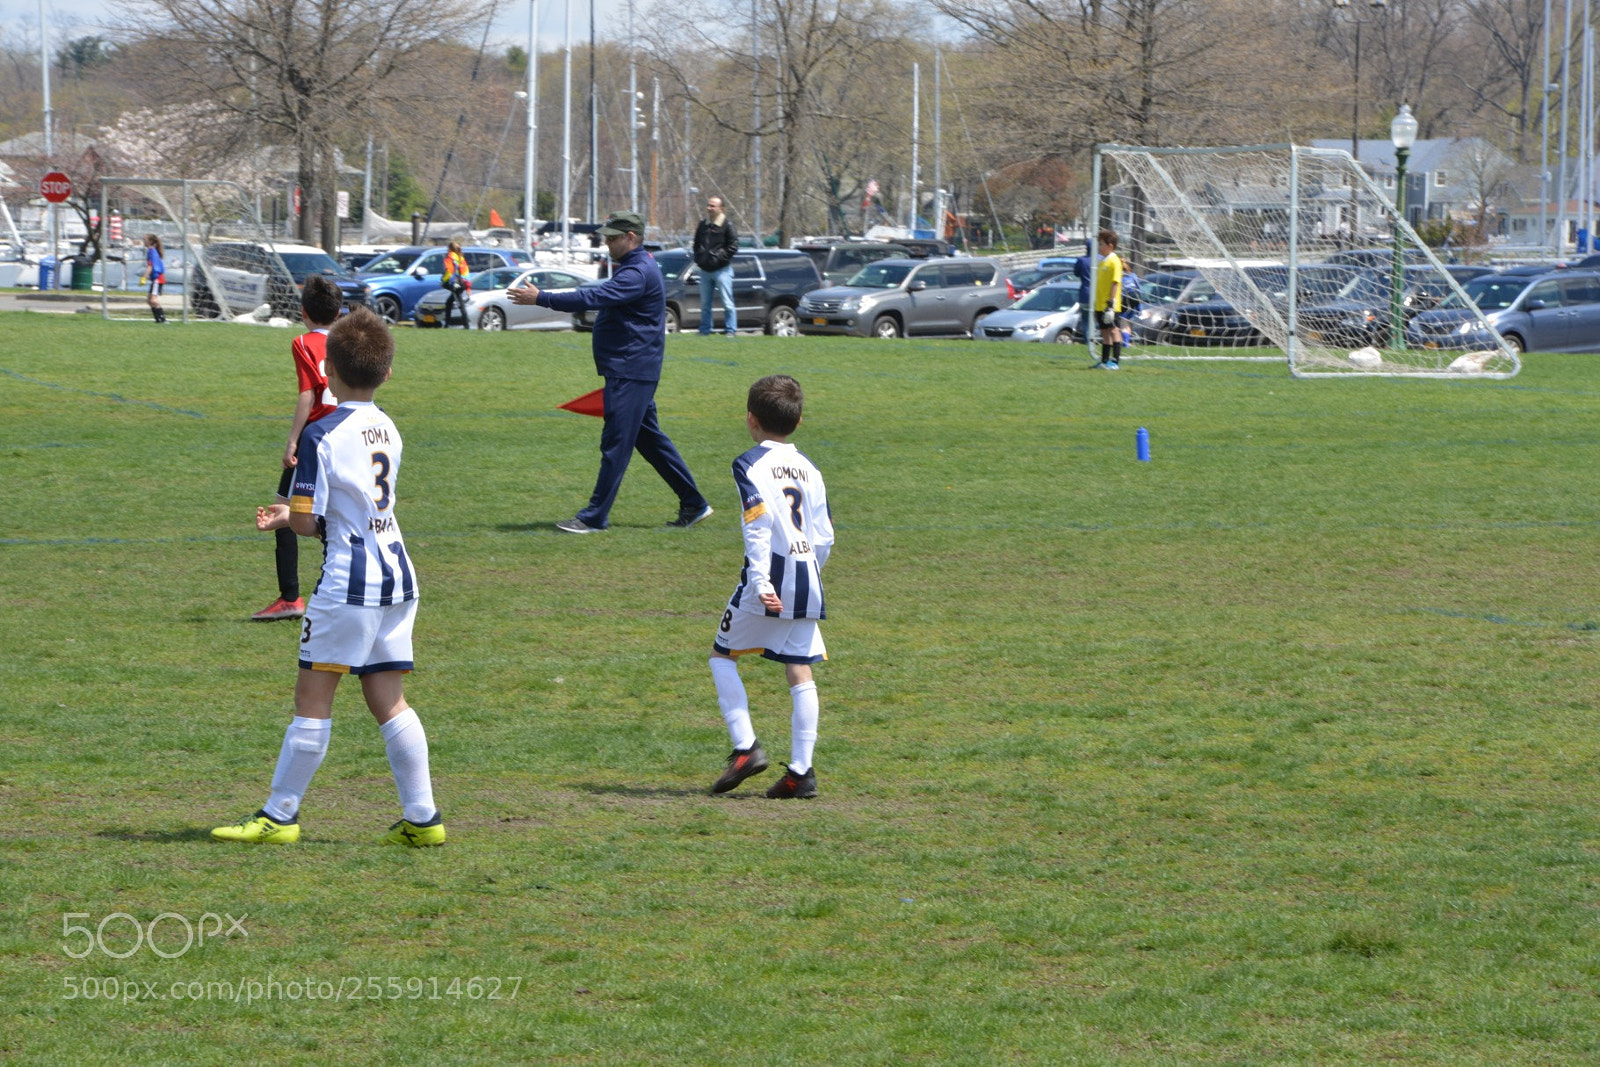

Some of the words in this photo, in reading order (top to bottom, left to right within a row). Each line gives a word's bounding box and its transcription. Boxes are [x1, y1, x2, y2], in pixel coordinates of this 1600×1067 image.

[42, 181, 71, 194] STOP
[361, 427, 391, 446] TOMA
[371, 451, 391, 512] 3
[771, 466, 809, 483] KOMONI
[301, 616, 312, 643] 3
[720, 608, 733, 633] 8
